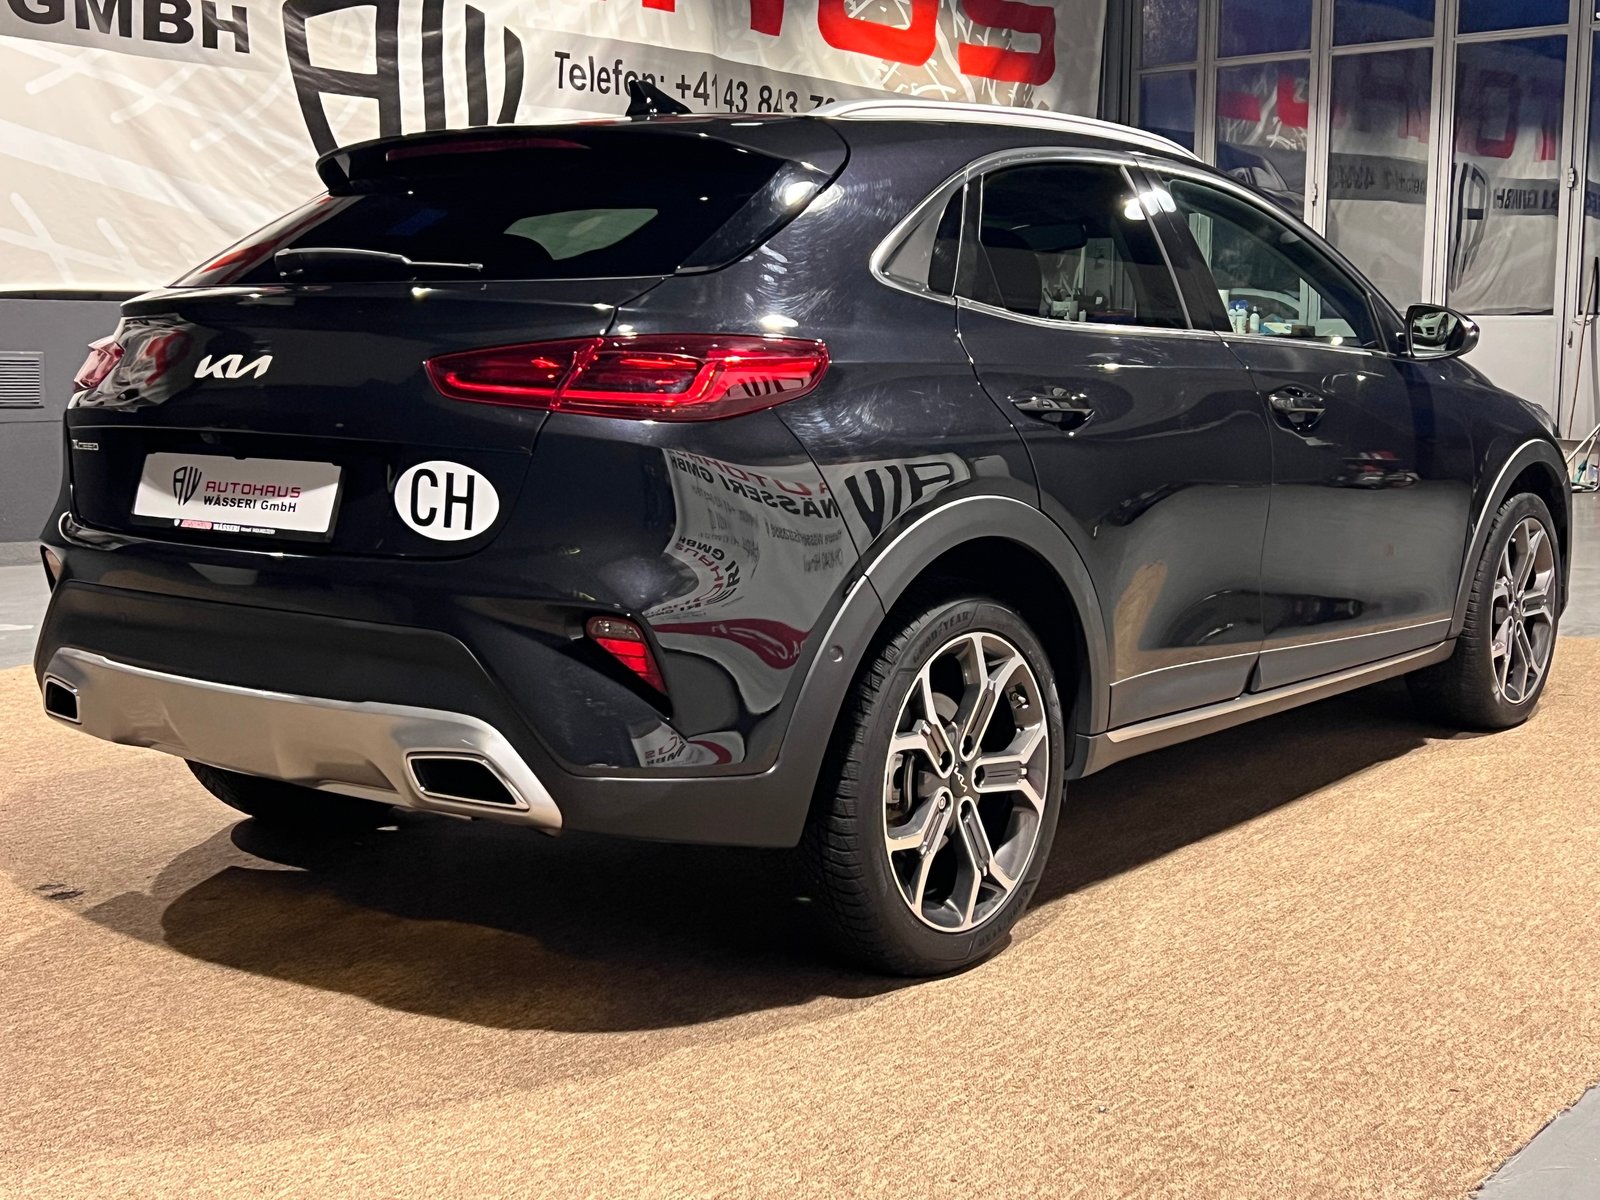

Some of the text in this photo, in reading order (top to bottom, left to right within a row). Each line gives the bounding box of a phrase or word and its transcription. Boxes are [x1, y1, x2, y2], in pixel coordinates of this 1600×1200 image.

[194, 353, 273, 379] KIA
[205, 481, 301, 498] AUTOHAUS
[410, 468, 475, 531] CH
[203, 494, 297, 513] WÄSSERI GmbH
